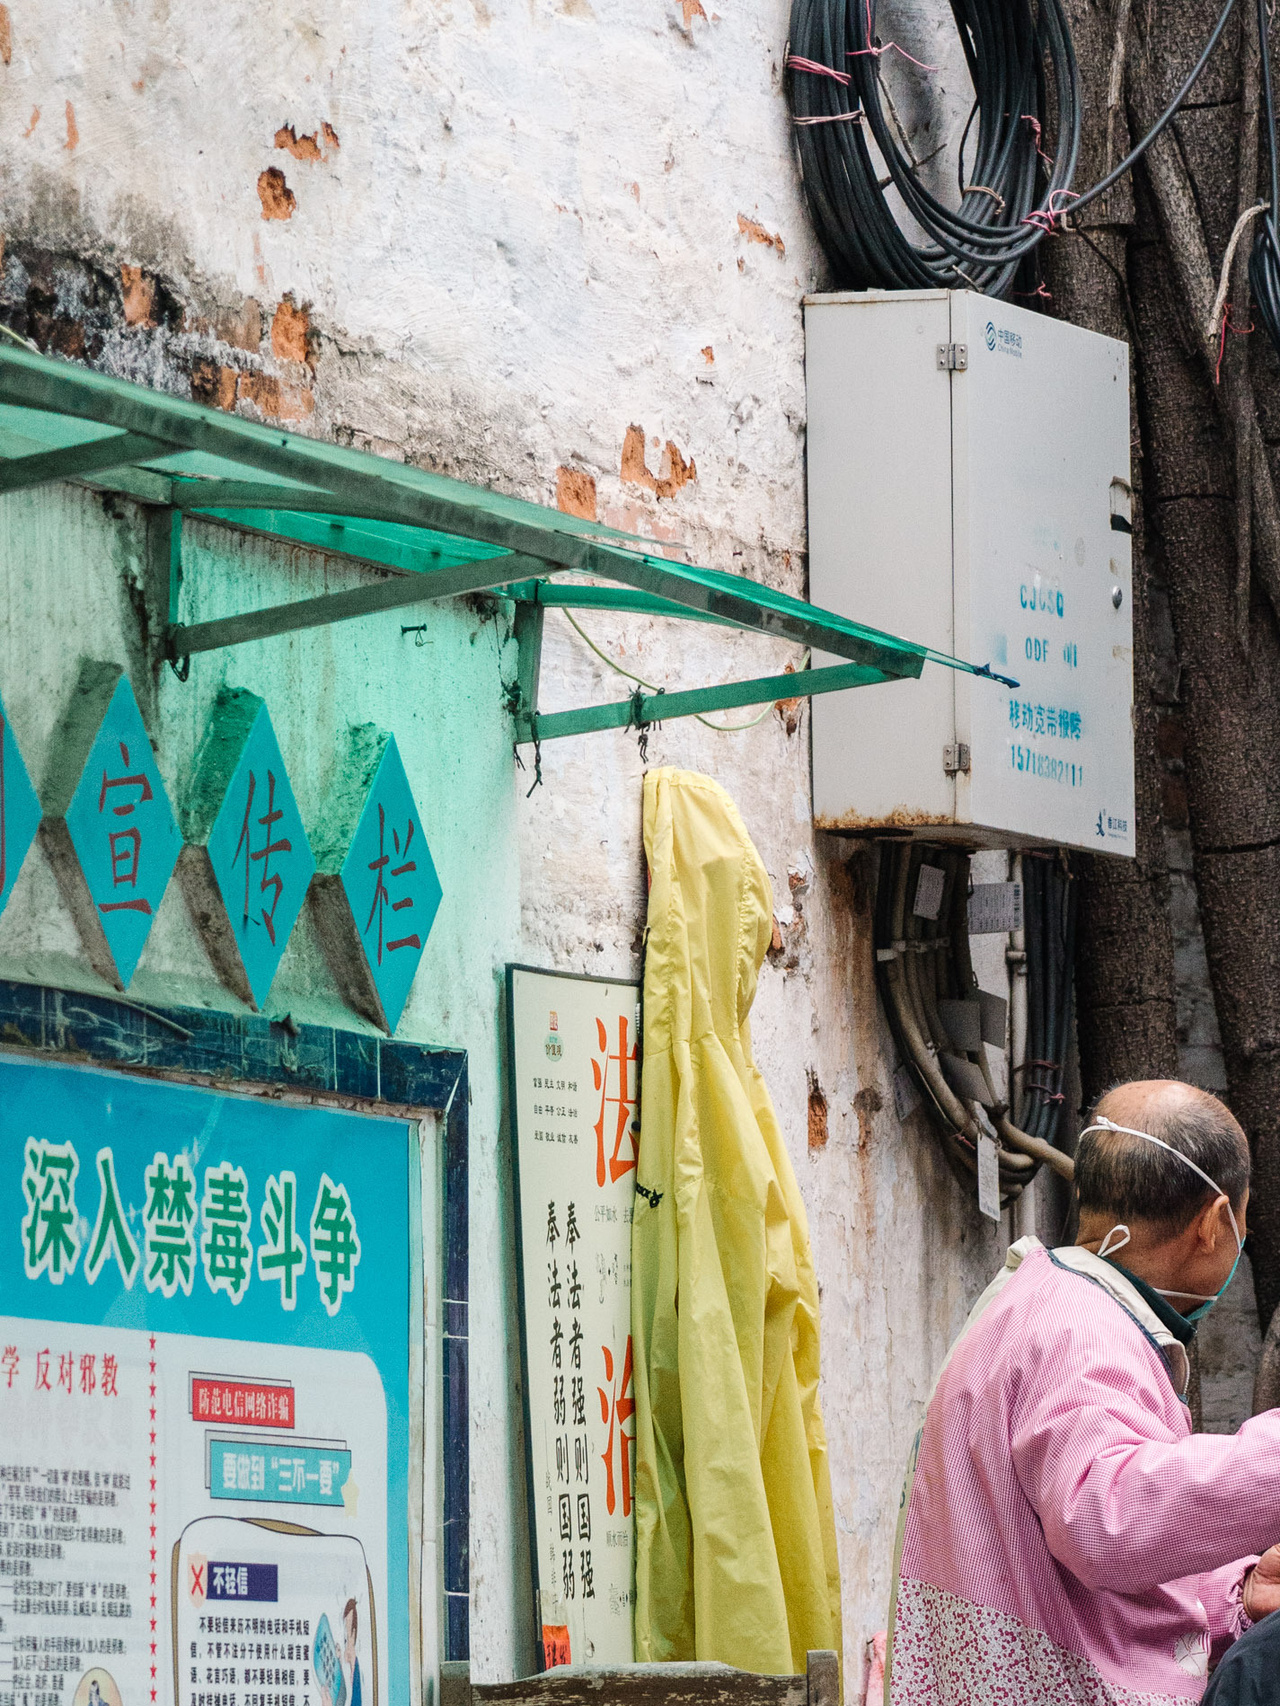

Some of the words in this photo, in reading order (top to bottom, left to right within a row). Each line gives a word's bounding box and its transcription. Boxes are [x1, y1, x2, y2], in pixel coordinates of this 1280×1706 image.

[1026, 637, 1048, 663] ODF
[22, 1136, 361, 1316] 深入禁毒斗争
[35, 1348, 118, 1397] 反对邪教
[199, 1388, 289, 1421] 防范电信网络诈骗
[213, 1566, 248, 1596] 不轻信
